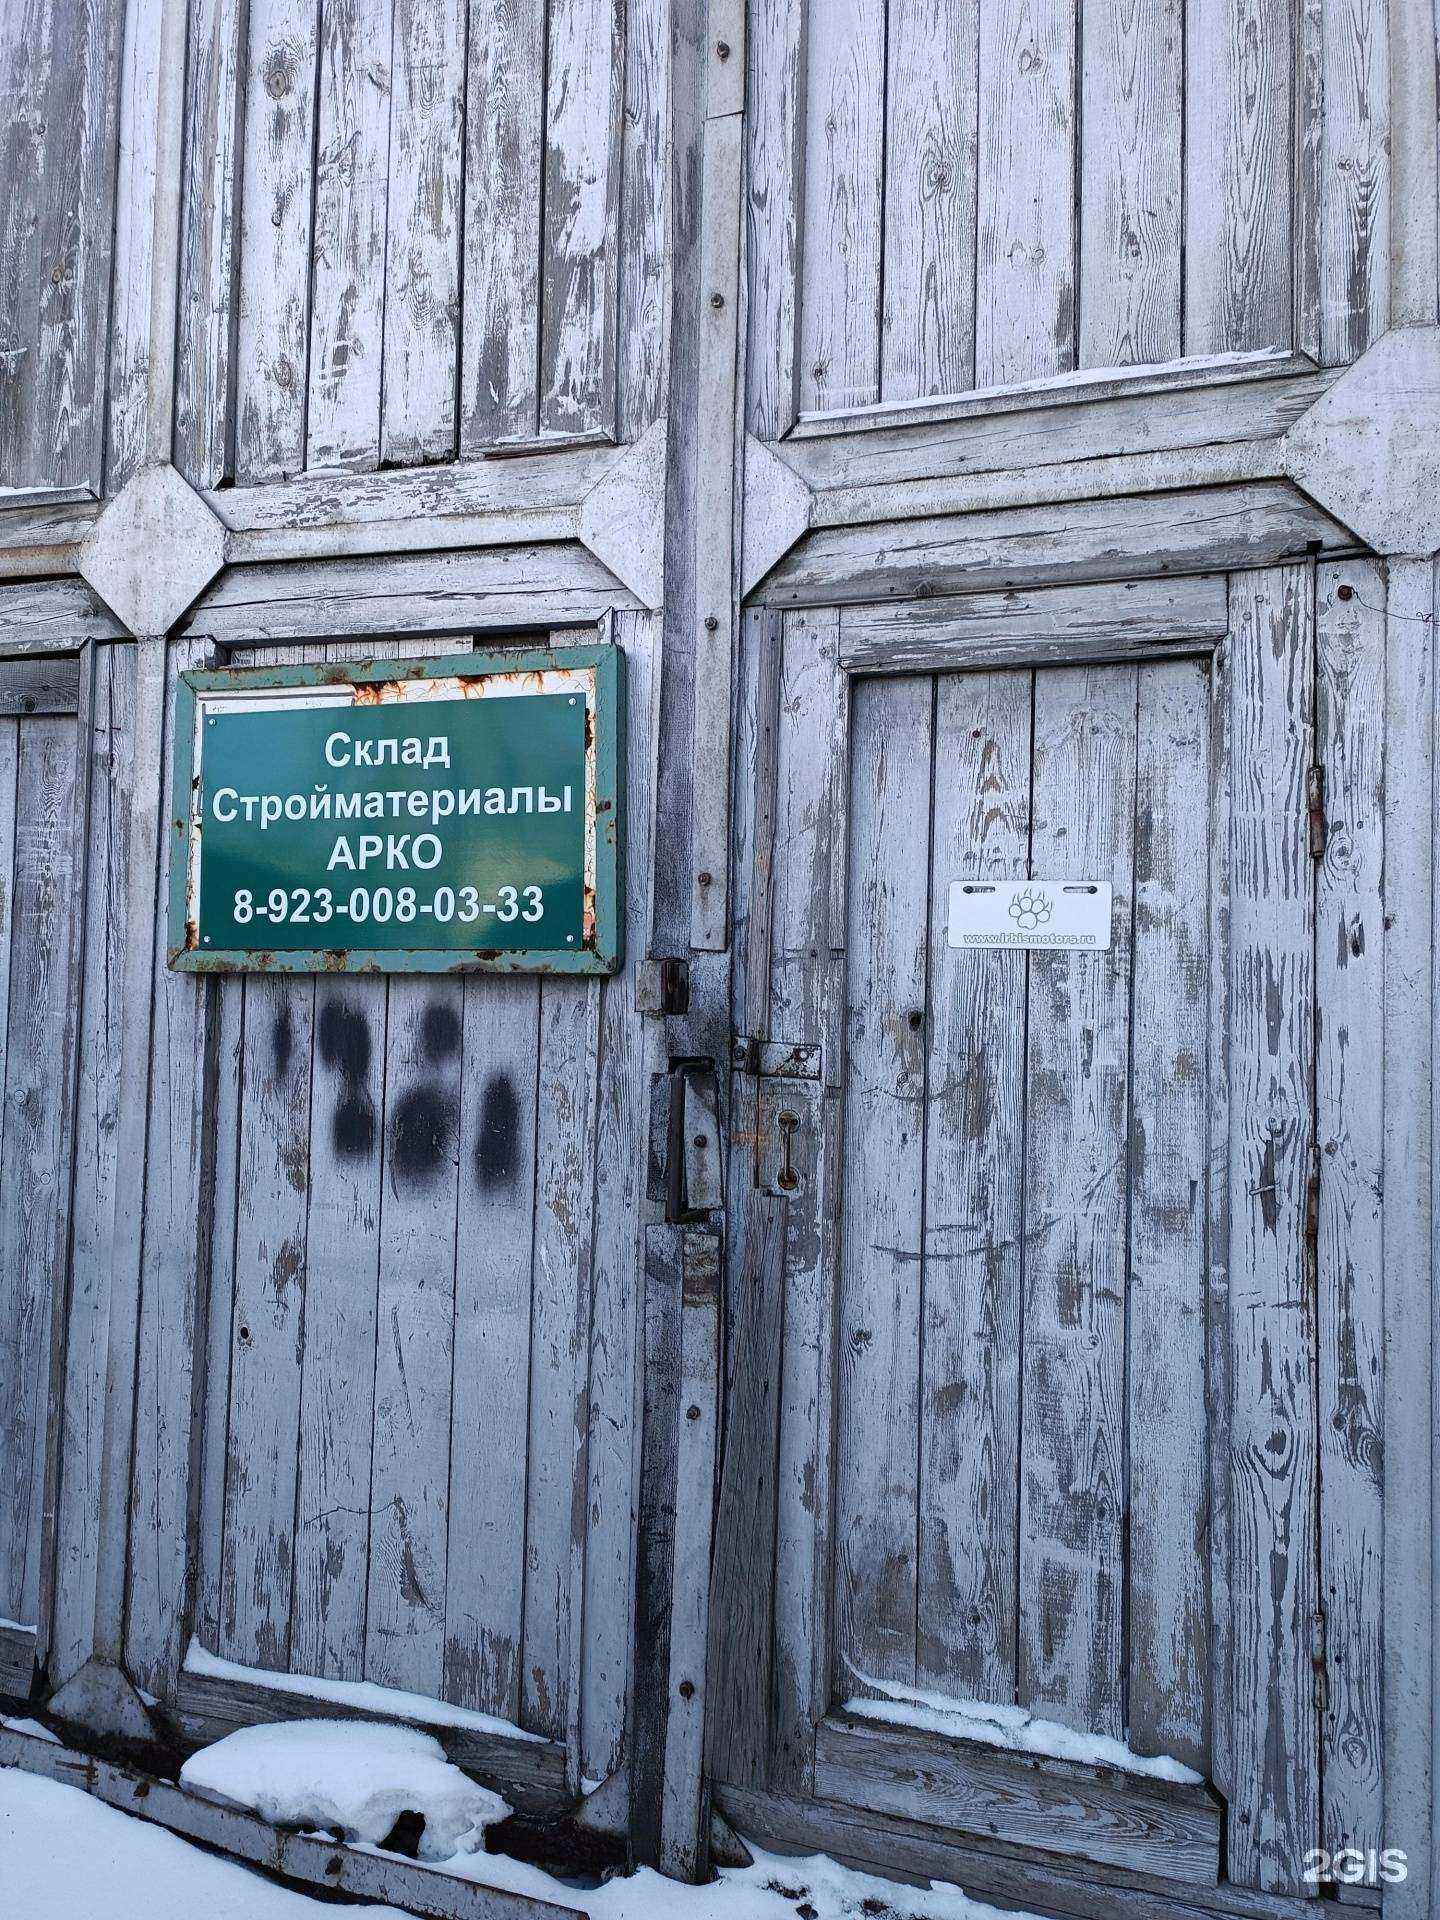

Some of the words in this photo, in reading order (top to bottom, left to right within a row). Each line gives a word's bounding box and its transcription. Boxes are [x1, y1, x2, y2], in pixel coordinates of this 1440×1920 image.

[324, 731, 451, 770] Склад
[212, 784, 573, 829] Стройматериалы
[326, 833, 443, 871] АРКО
[233, 885, 545, 925] 8-923-008-03-33
